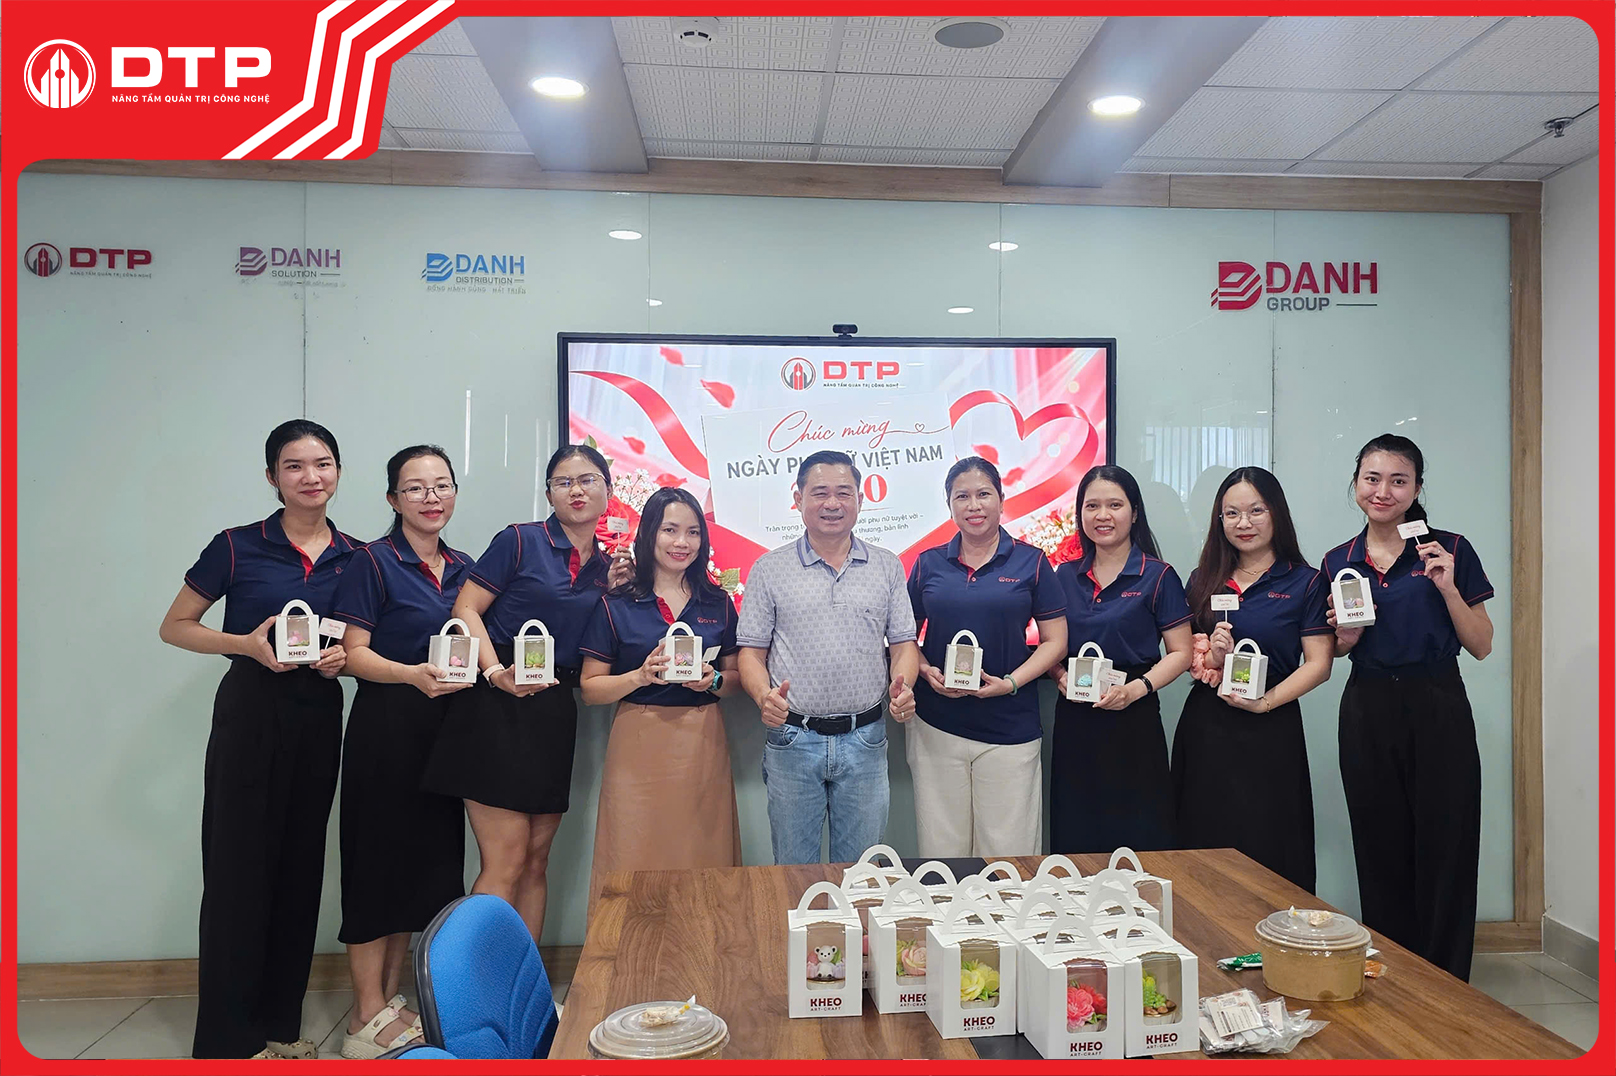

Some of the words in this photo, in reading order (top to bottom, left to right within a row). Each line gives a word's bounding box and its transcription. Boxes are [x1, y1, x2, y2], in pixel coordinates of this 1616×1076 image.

[69, 247, 152, 270] DTP
[271, 247, 341, 268] DANH
[455, 253, 525, 275] DANH
[271, 270, 317, 278] SOLUTION
[455, 276, 513, 284] DISTRIBUTION
[1265, 261, 1378, 294] DANH
[1266, 297, 1330, 311] GROUP
[823, 361, 900, 380] DTP
[767, 410, 836, 453] Chúc
[841, 419, 891, 449] mừng
[726, 454, 781, 479] NGÀY
[861, 446, 900, 470] VIỆT
[905, 444, 943, 464] NAM
[810, 997, 842, 1007] KHEO
[963, 1016, 996, 1027] KHEO
[1070, 1041, 1103, 1052] KHEO
[1146, 1032, 1178, 1045] KHEO
